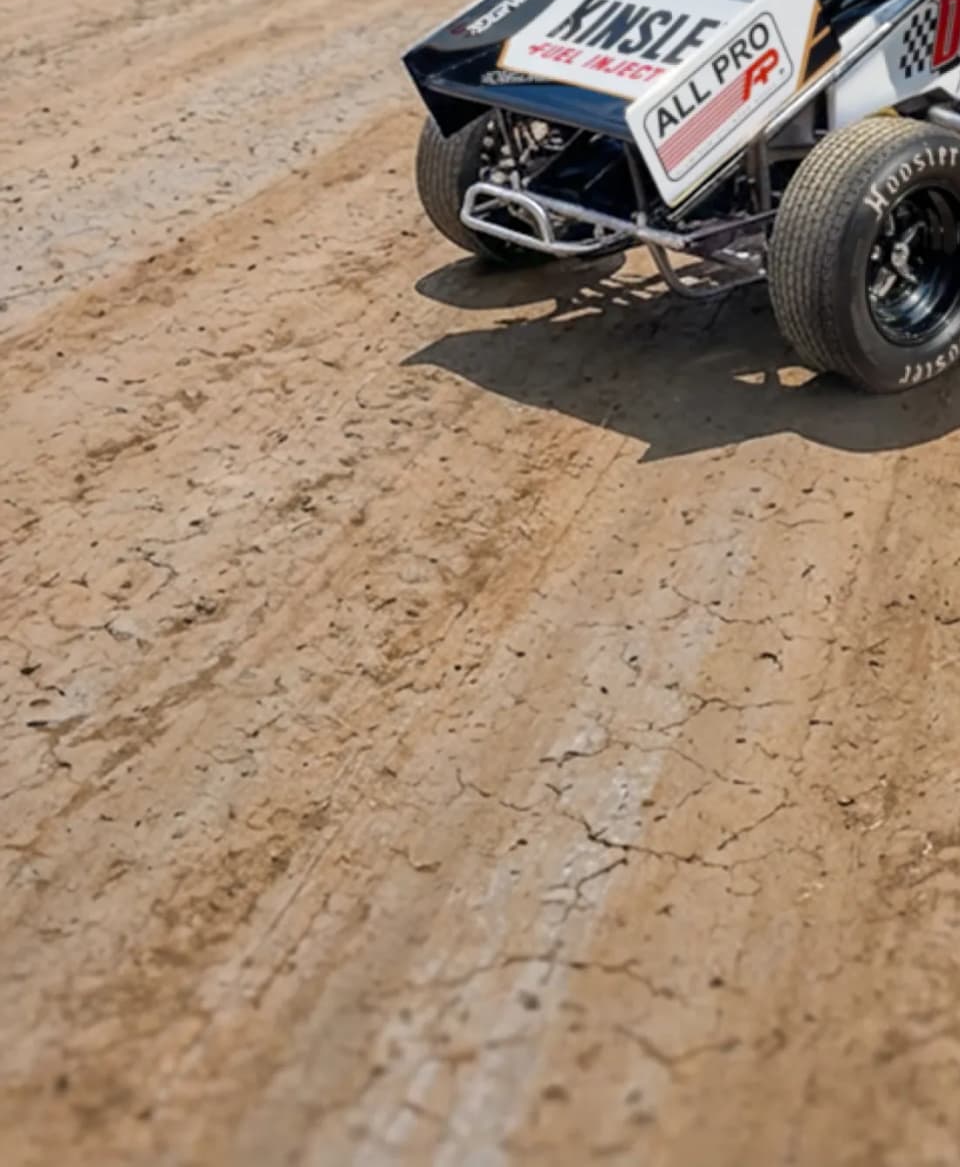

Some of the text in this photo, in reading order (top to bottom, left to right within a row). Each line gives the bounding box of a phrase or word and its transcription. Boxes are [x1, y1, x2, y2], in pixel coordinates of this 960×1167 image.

[530, 42, 584, 65] FUEL
[657, 20, 772, 138] ALL PRO
[863, 143, 960, 222] Hoosier
